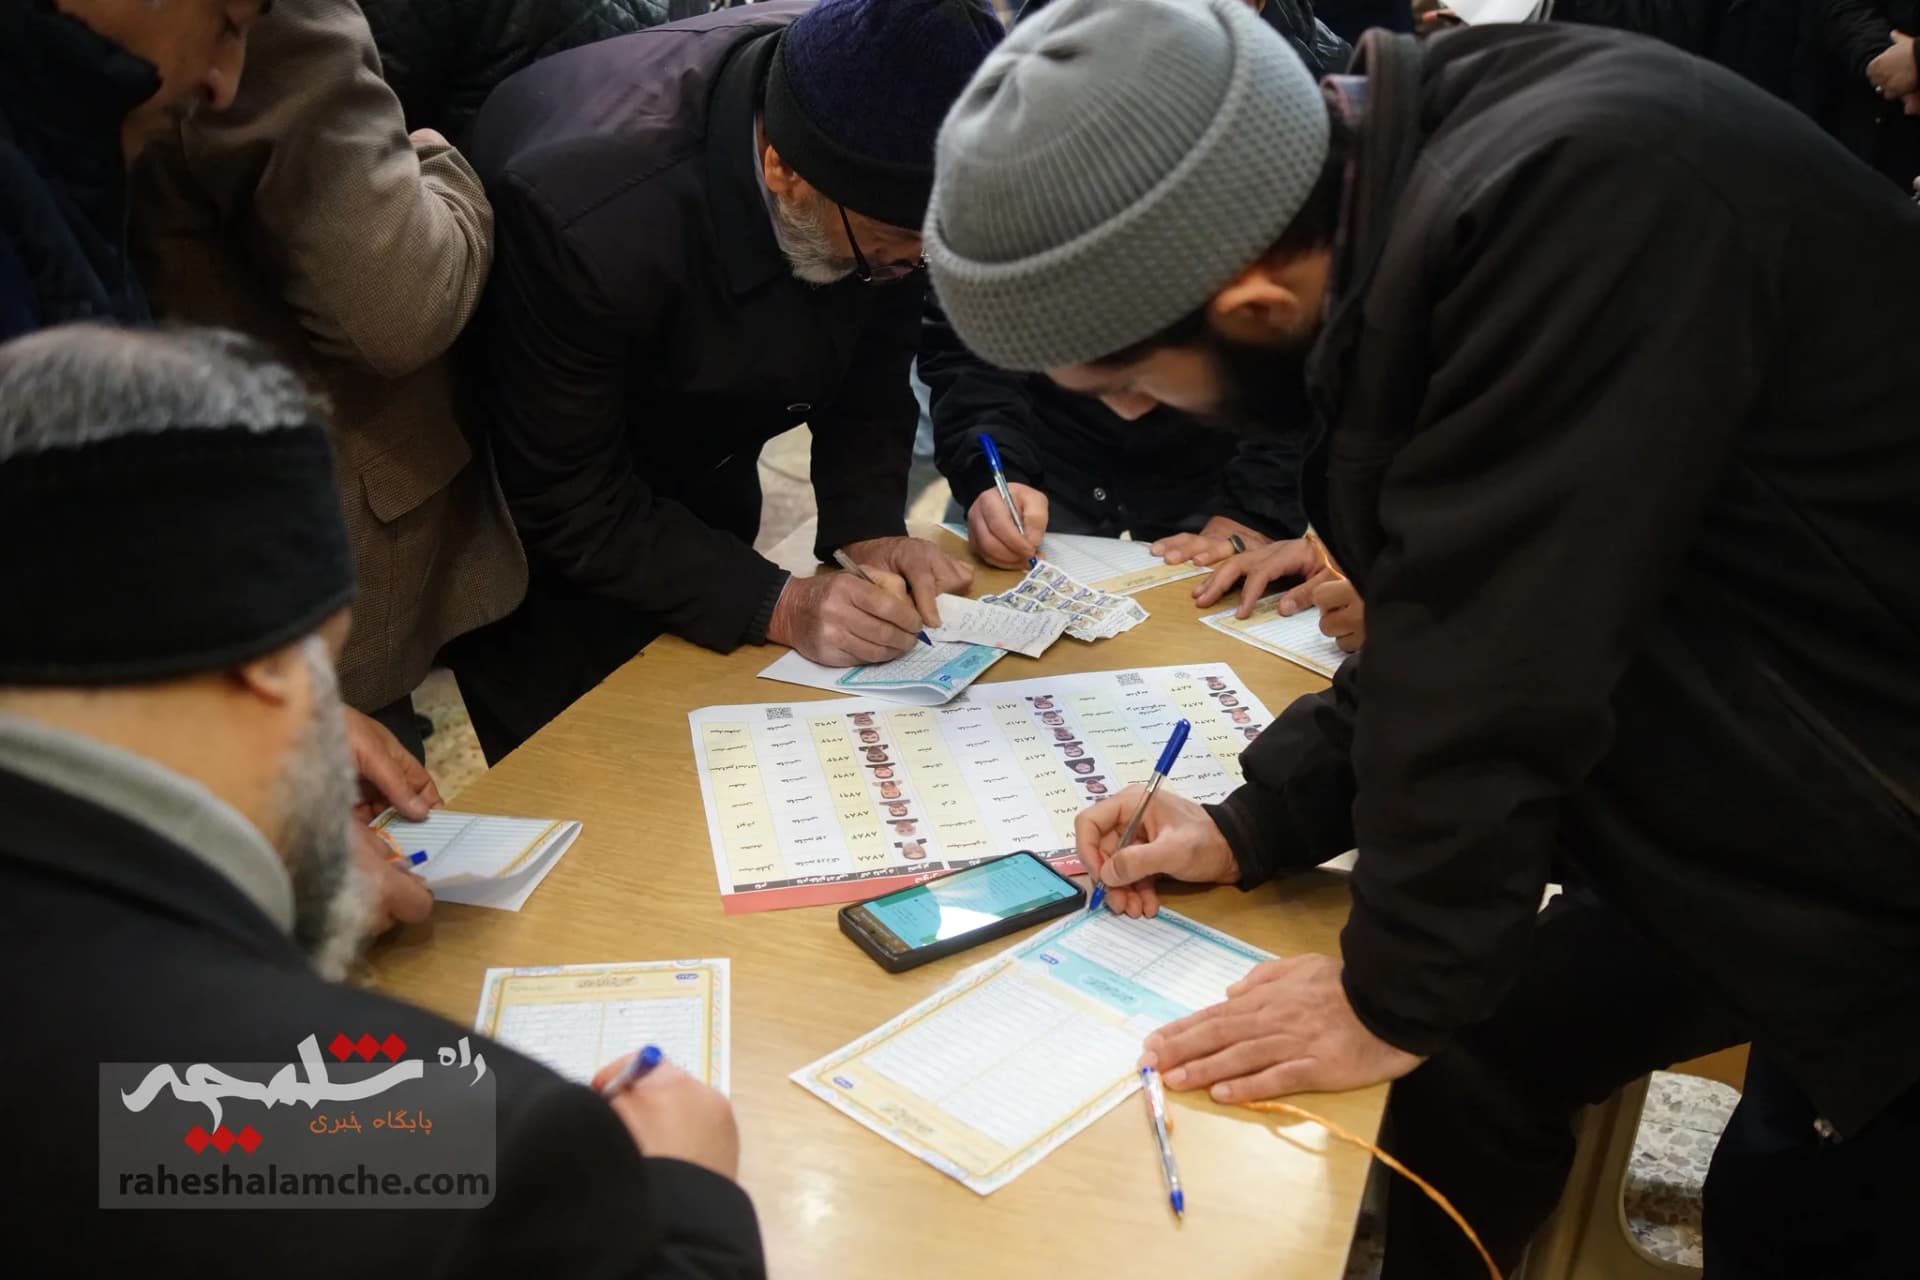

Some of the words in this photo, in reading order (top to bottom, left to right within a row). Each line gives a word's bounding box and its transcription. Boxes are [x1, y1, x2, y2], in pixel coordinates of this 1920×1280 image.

[766, 723, 791, 731] هاشمی
[771, 740, 796, 748] هاشمی
[965, 740, 991, 748] هاشمی
[776, 759, 801, 767] هاشمی
[974, 758, 999, 766] هاشمی
[780, 776, 807, 784] هاشمی
[983, 776, 1009, 785] هاشمی
[838, 791, 862, 799] ۸۷۹۱
[991, 795, 1018, 803] هاشمی
[786, 795, 812, 804] هاشمی
[791, 816, 818, 825] هاشمی
[1002, 814, 1029, 824] هاشمی
[1011, 834, 1039, 843] هاشمی
[856, 853, 886, 863] ۸۷۸۸
